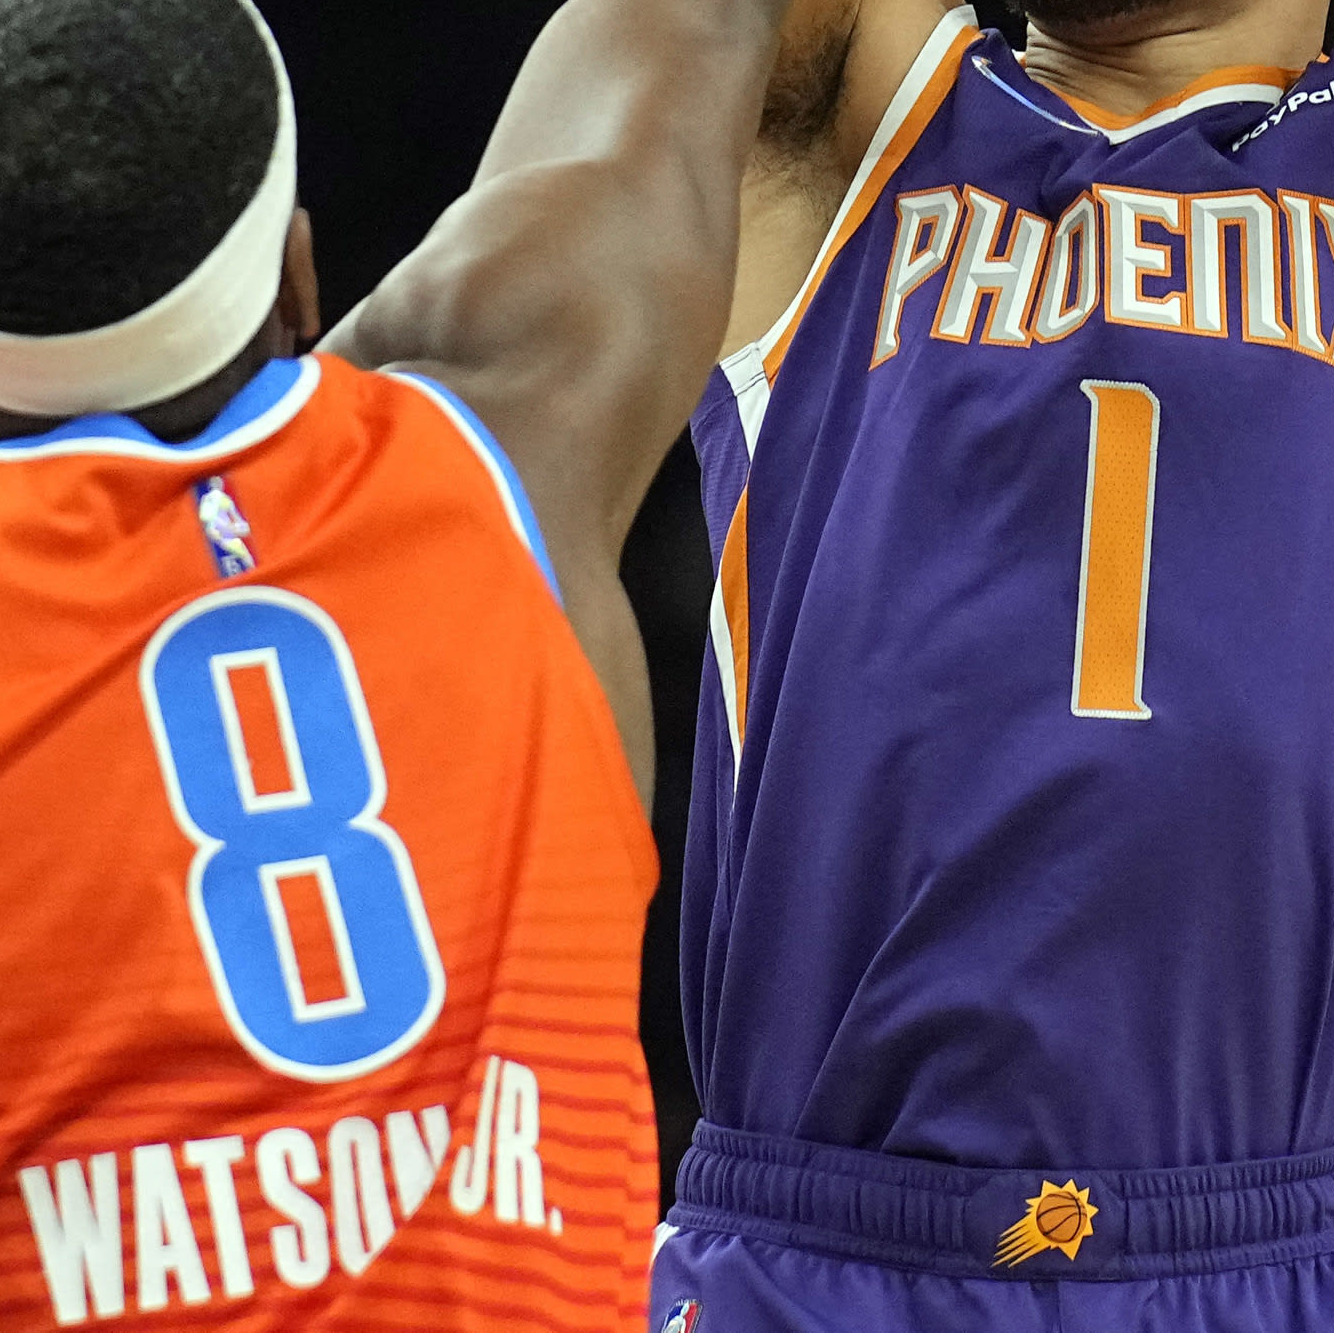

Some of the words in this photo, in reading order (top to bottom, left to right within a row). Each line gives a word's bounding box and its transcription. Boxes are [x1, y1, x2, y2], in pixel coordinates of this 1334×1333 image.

[1071, 378, 1161, 719] 1
[139, 585, 446, 1084] 8
[18, 1104, 451, 1326] WATSON
[449, 1054, 562, 1235] JR.
